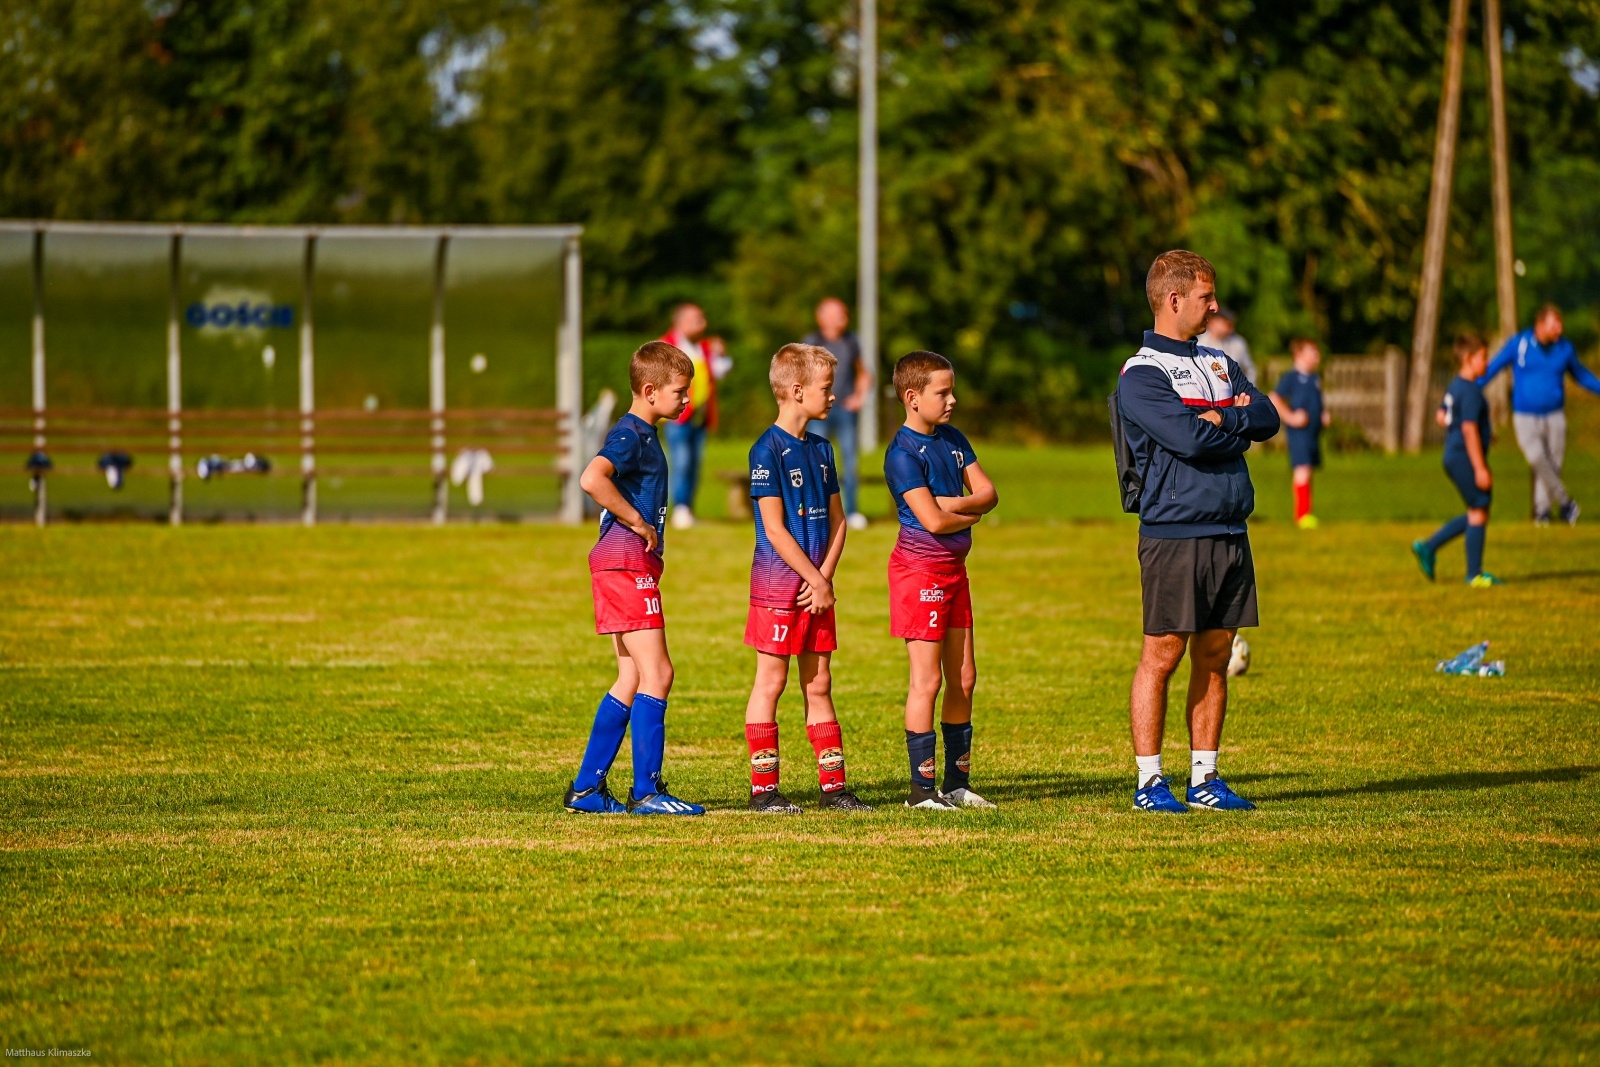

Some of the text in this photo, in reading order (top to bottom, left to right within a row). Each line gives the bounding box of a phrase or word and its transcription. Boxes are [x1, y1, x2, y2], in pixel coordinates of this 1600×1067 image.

[644, 597, 660, 615] 10
[929, 610, 938, 628] 2
[772, 624, 788, 643] 17
